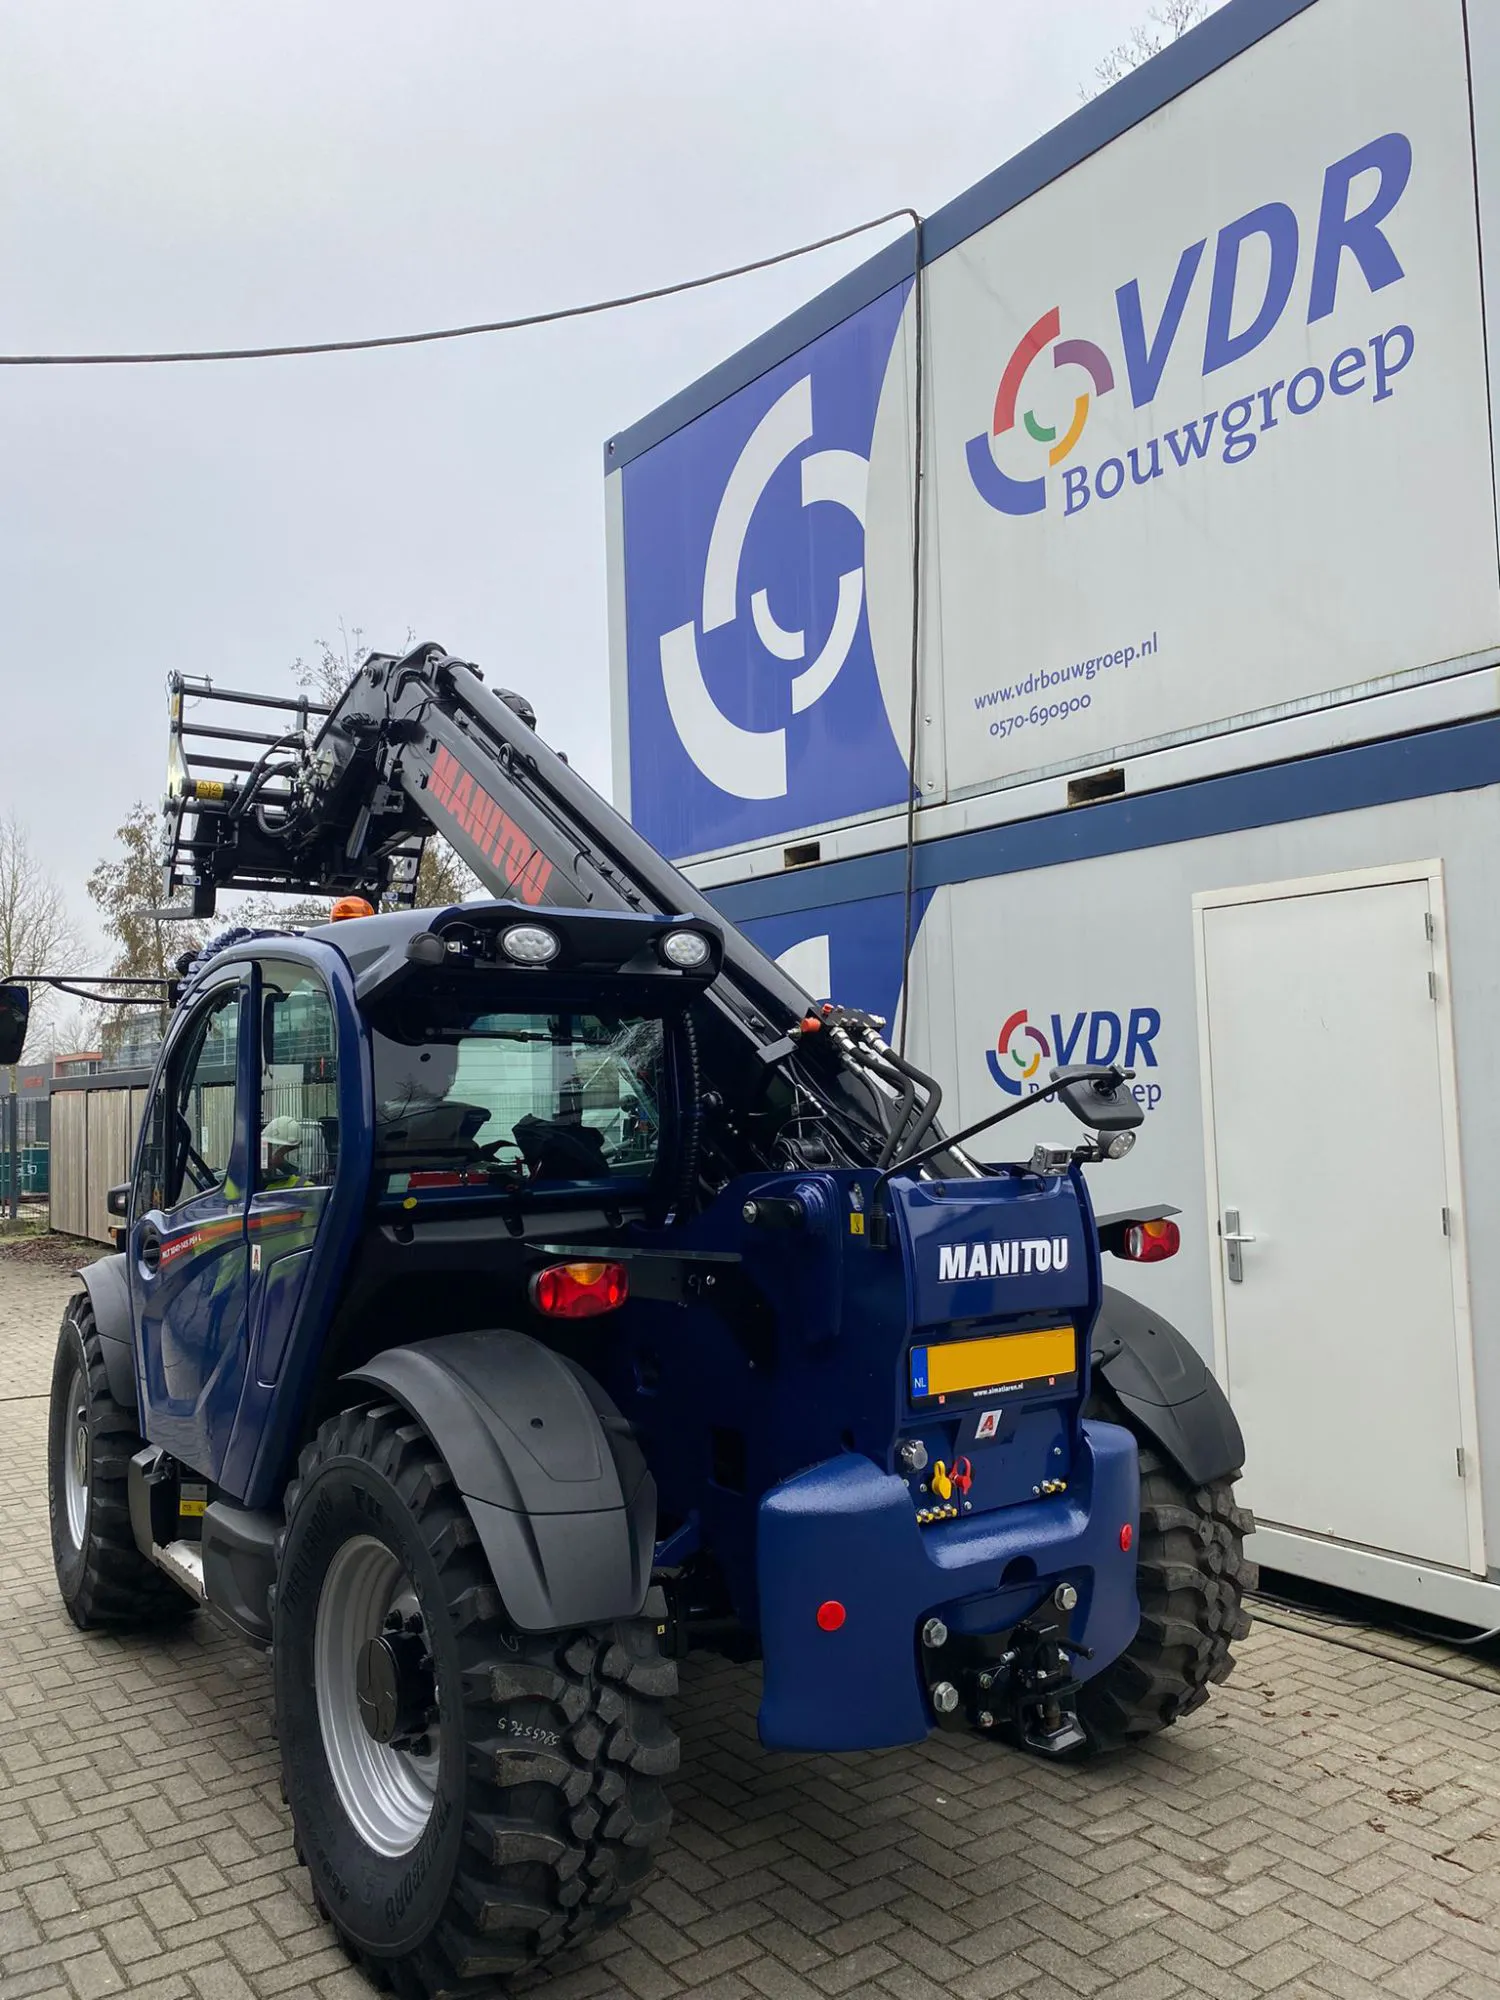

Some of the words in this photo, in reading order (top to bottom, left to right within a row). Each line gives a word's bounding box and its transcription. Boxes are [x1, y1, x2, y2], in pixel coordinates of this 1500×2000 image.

[1115, 132, 1413, 410] VDR
[1062, 323, 1415, 517] Bouwgroep
[973, 631, 1159, 711] www.vdrbouwgroep.nl
[989, 693, 1092, 739] 0570-690900
[427, 744, 553, 906] MANITOU
[1050, 1007, 1161, 1068] VDR
[938, 1238, 1069, 1281] MANITOU
[914, 1377, 927, 1389] NL
